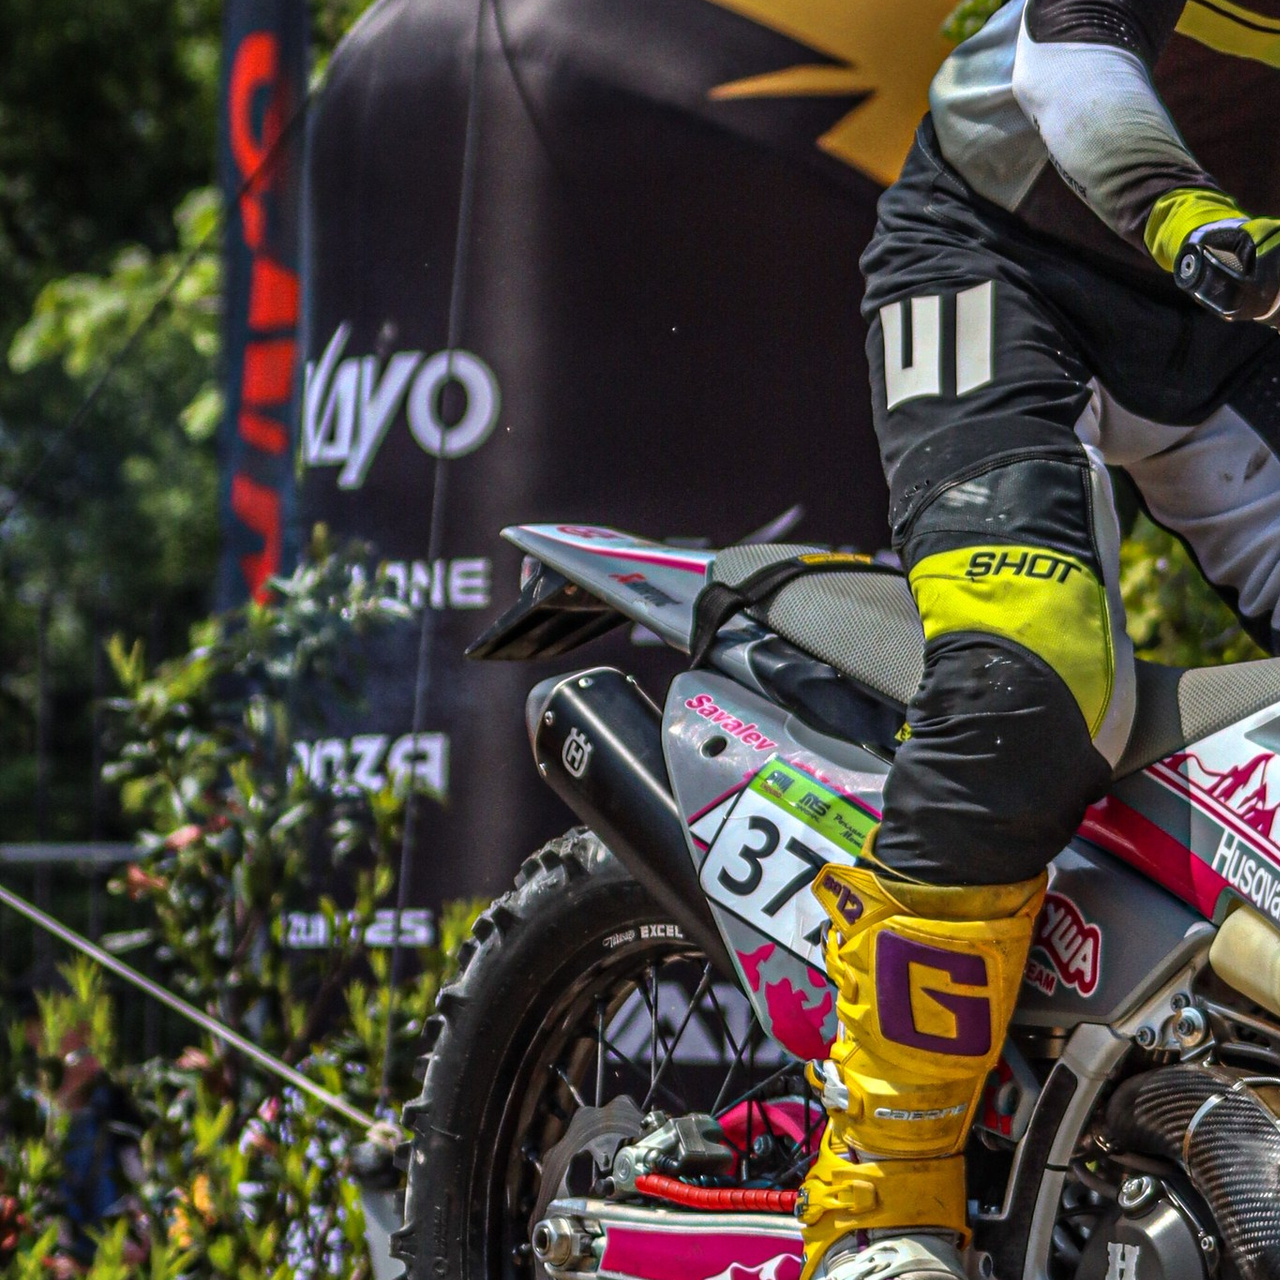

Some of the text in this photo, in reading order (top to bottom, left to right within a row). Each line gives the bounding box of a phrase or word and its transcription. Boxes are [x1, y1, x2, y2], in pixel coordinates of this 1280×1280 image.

[964, 551, 1083, 585] SHOT
[684, 692, 778, 753] Savalev
[716, 814, 832, 947] 37
[639, 923, 684, 940] EXCEL
[1025, 960, 1057, 994] EAM
